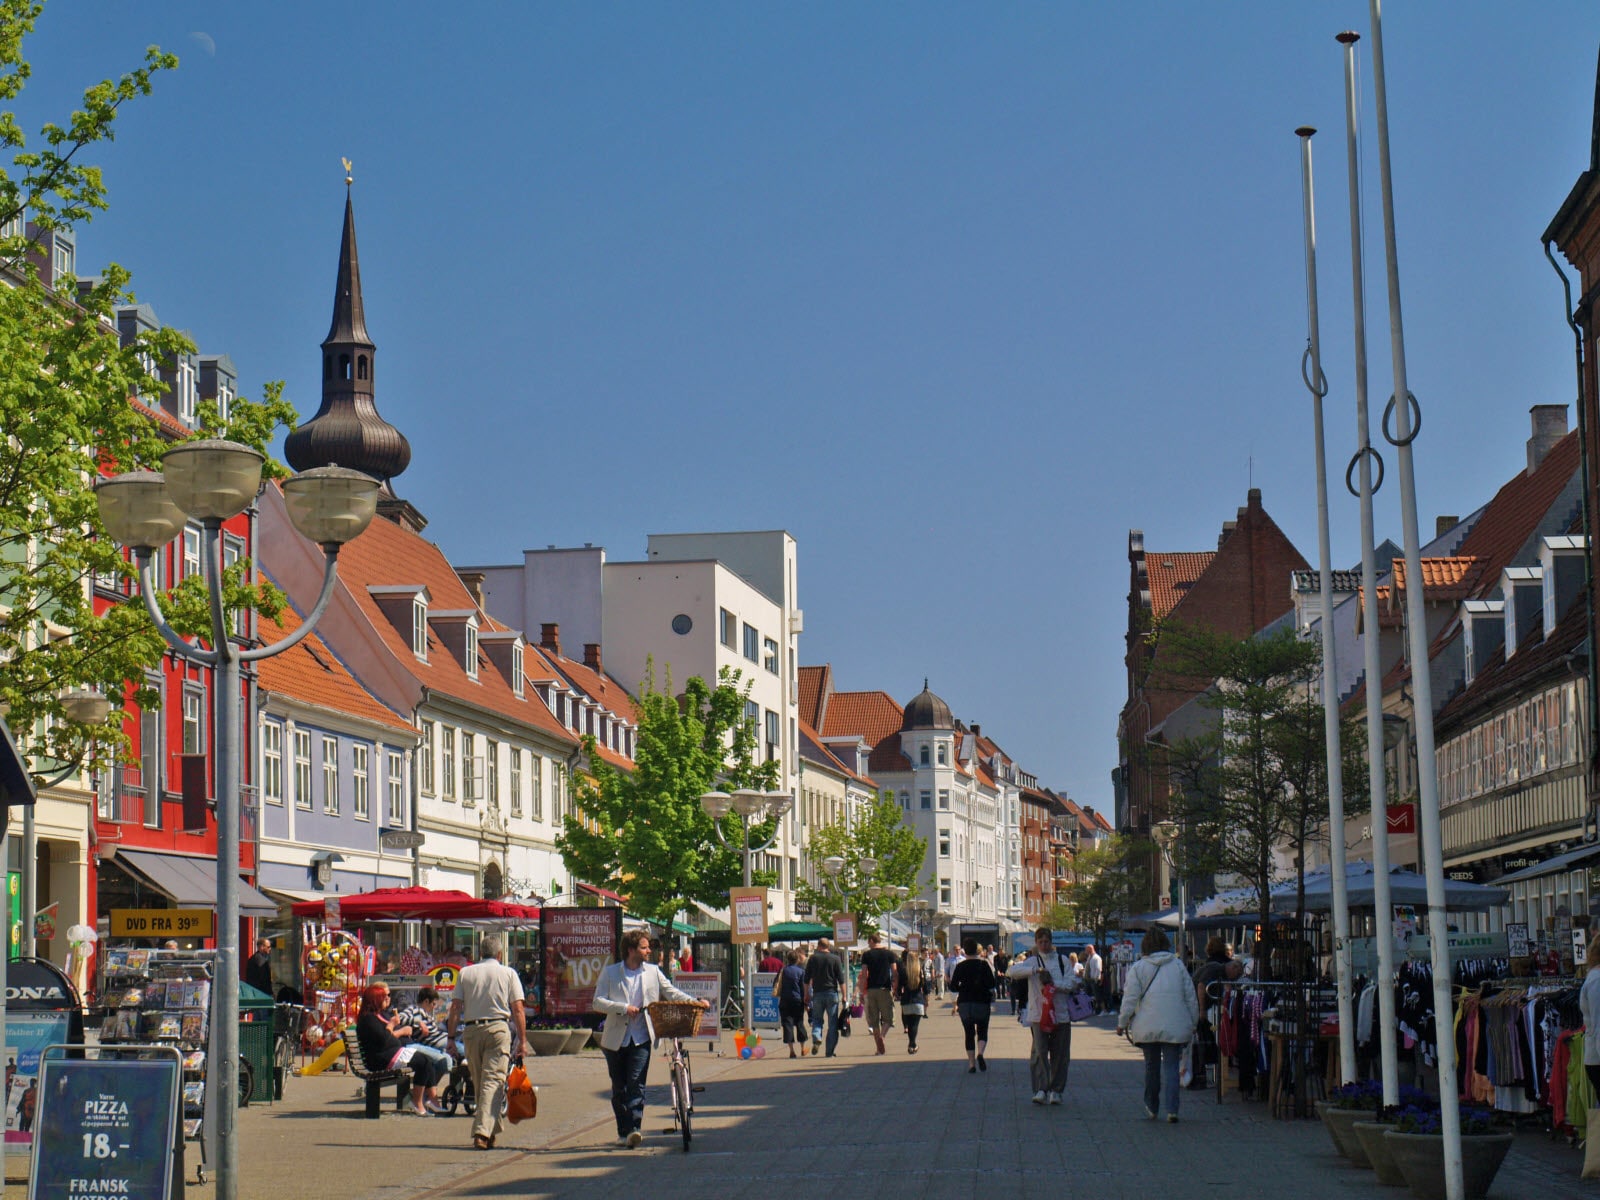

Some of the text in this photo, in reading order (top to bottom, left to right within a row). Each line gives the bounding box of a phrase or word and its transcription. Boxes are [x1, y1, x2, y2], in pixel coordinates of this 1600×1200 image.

[386, 836, 418, 845] NEYE
[1449, 871, 1474, 880] SEEDS
[126, 918, 147, 930] DVD
[151, 917, 172, 930] FRA
[553, 914, 610, 924] EN HELT SÆRLIG
[572, 925, 611, 934] HILSEN TIL
[552, 936, 611, 945] KONFIRMANDER
[575, 946, 611, 955] HORSENS
[567, 955, 611, 987] 10%
[5, 986, 66, 1000] ONA
[755, 1007, 777, 1018] 50%
[84, 1100, 129, 1115] PIZZA
[83, 1132, 130, 1159] 18.-
[69, 1179, 129, 1193] FRANSK
